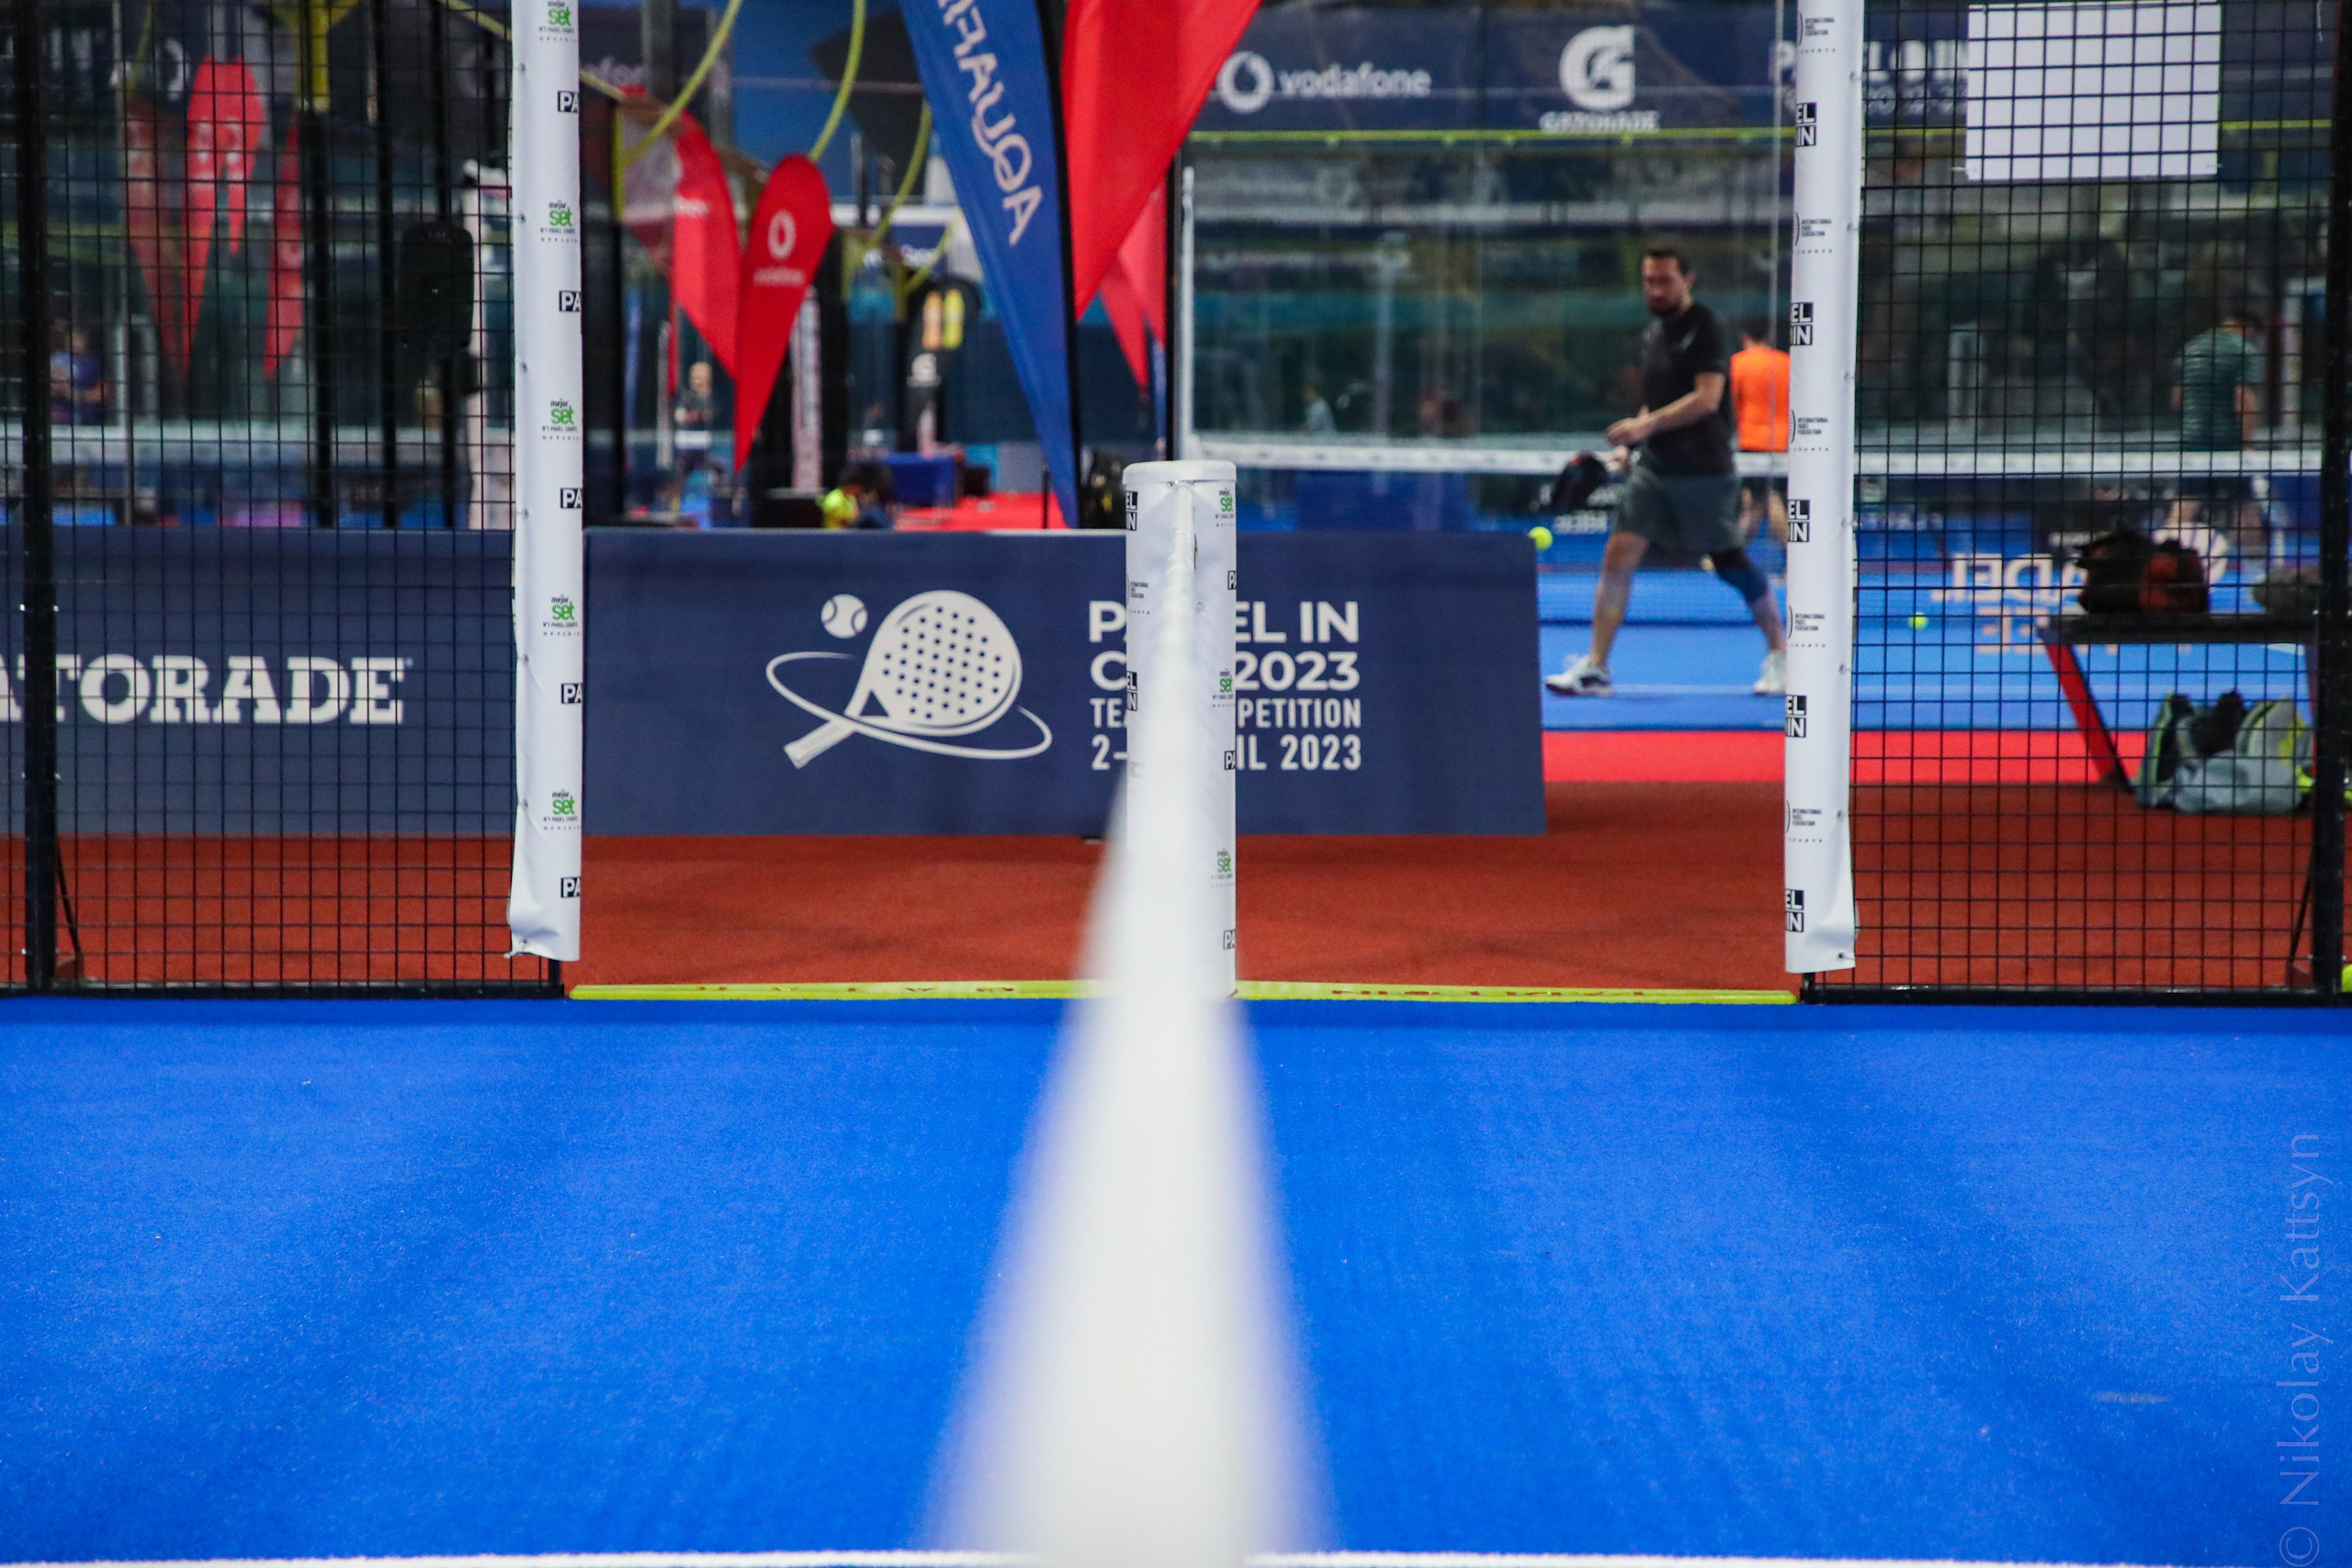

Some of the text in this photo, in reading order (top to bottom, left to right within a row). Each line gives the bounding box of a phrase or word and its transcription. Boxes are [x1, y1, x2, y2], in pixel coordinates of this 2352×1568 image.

[548, 6, 571, 26] set
[1280, 62, 1431, 98] vodafone
[549, 207, 572, 227] set
[551, 405, 574, 424] set
[551, 594, 569, 604] mejor
[552, 602, 575, 620] set
[1299, 601, 1360, 643] IN
[1236, 649, 1361, 691] 2023
[1238, 697, 1362, 728] PETITION
[1280, 733, 1362, 771] 2023
[553, 796, 575, 815] set
